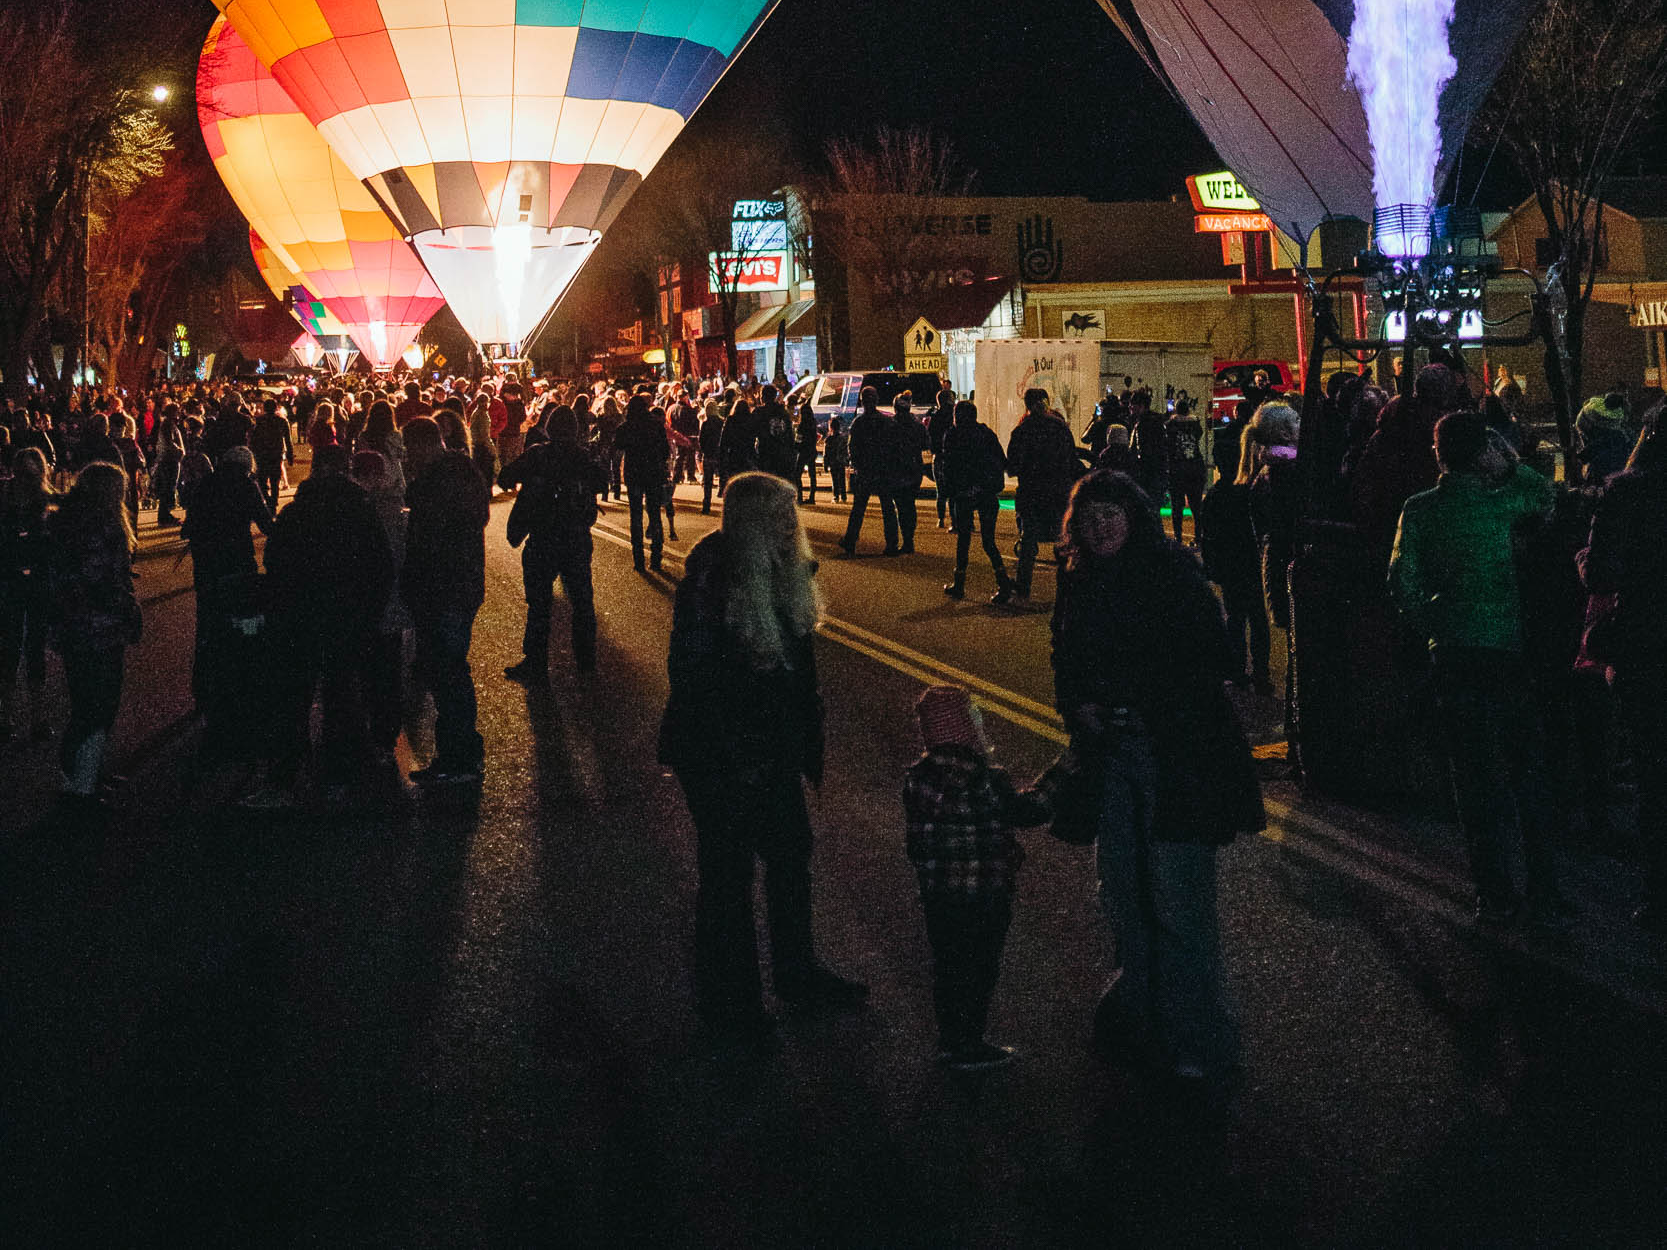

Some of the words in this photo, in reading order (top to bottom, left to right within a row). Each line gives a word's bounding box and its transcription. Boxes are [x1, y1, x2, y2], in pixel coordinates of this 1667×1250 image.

[1207, 181, 1253, 199] WEL
[733, 200, 767, 218] FOX
[1204, 216, 1270, 229] VACANCY
[908, 359, 940, 370] AHEAD
